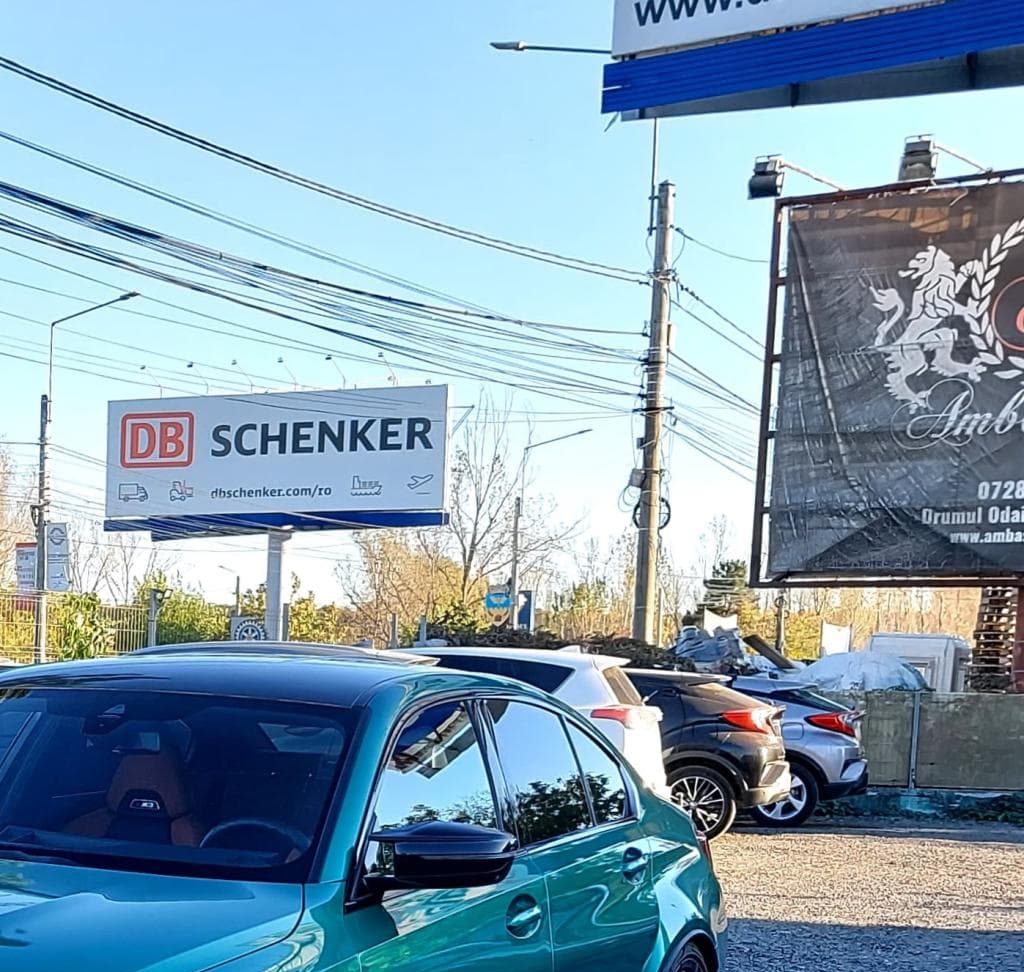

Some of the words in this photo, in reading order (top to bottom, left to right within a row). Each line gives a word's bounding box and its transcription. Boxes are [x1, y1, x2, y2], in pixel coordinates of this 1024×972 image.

[634, 0, 769, 27] www.
[890, 377, 1024, 450] Amb
[129, 421, 185, 460] DB
[210, 416, 434, 458] SCHENKER
[210, 485, 332, 500] dbschenker.com/ro
[977, 480, 1024, 500] 0728
[921, 507, 983, 525] Drumul
[949, 528, 1024, 544] www.amba
